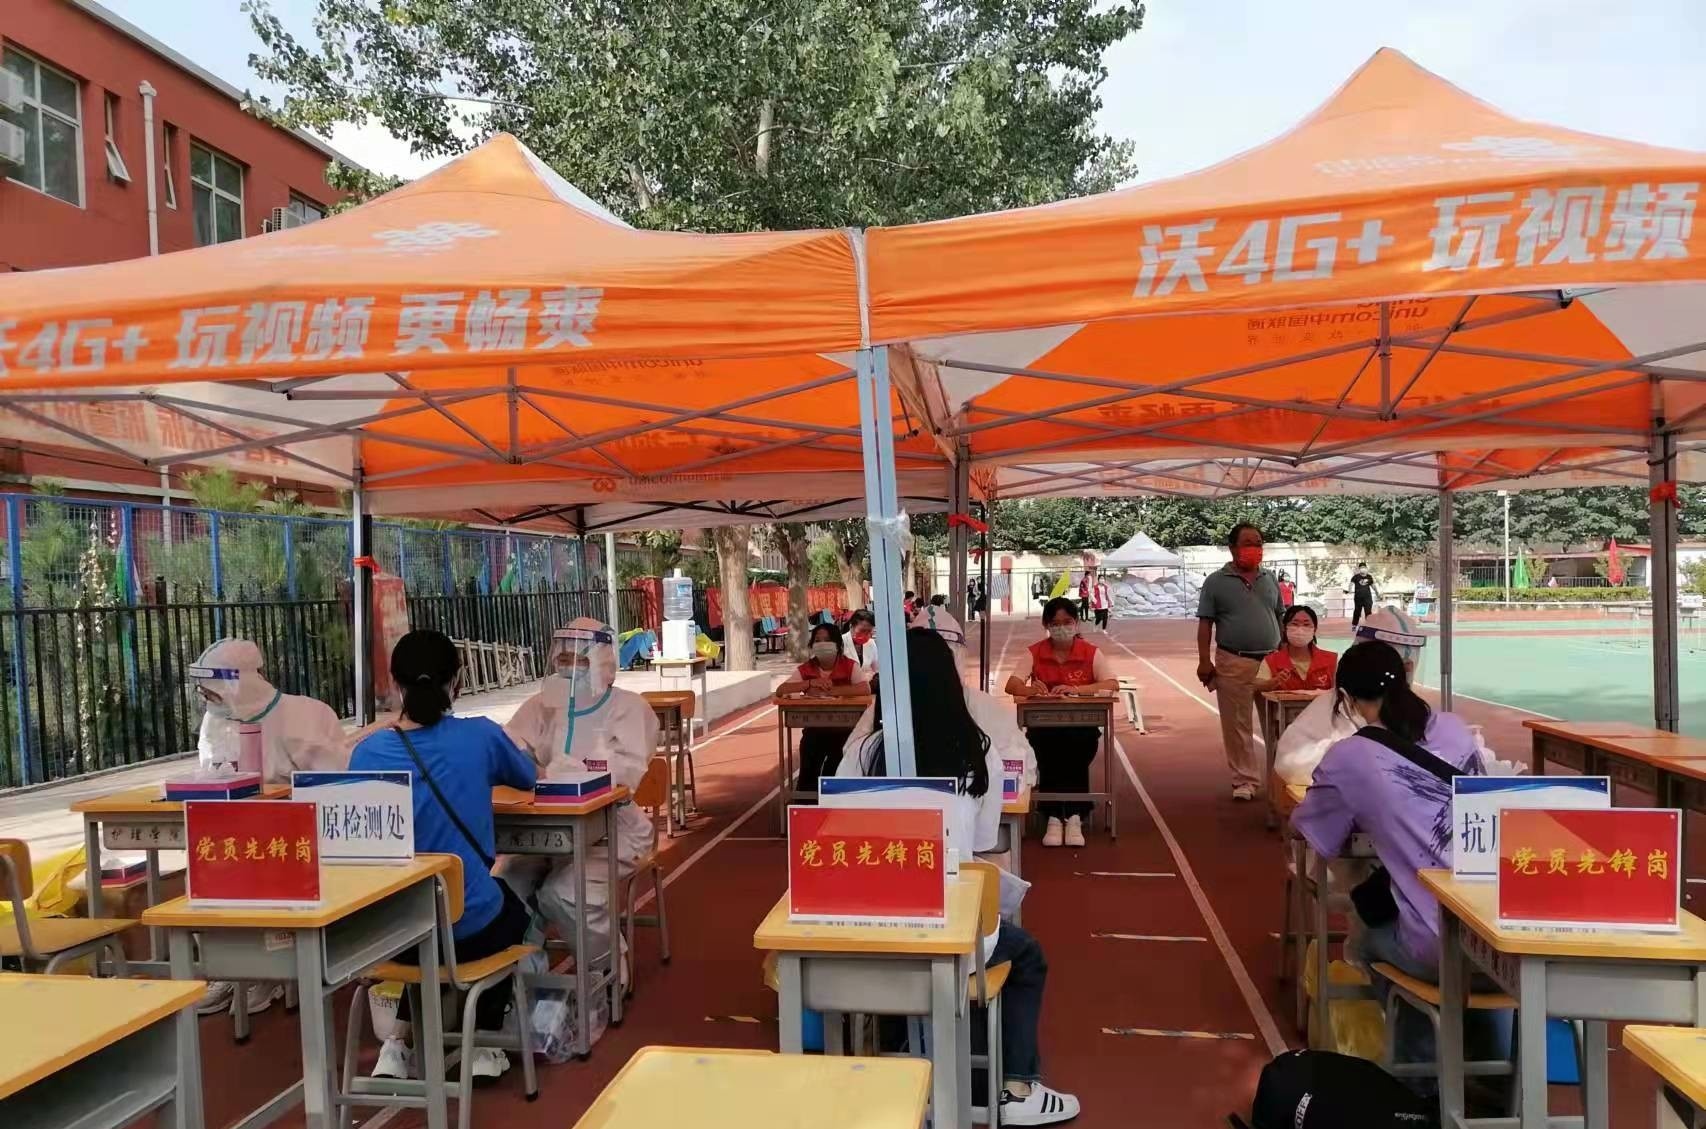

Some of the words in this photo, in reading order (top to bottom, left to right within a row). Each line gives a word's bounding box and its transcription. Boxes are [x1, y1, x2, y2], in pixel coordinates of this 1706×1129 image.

[1133, 211, 1393, 298] 沃4G+
[1422, 182, 1699, 272] 玩视频
[0, 317, 150, 378] 4G+
[168, 297, 375, 370] 玩视频
[390, 286, 605, 357] 更畅爽
[321, 804, 405, 841] 原检测处
[1461, 811, 1497, 853] 抗
[195, 836, 312, 864] 党员先锋岗
[799, 839, 935, 870] 党员先锋岗
[1511, 847, 1668, 880] 党员先锋岗
